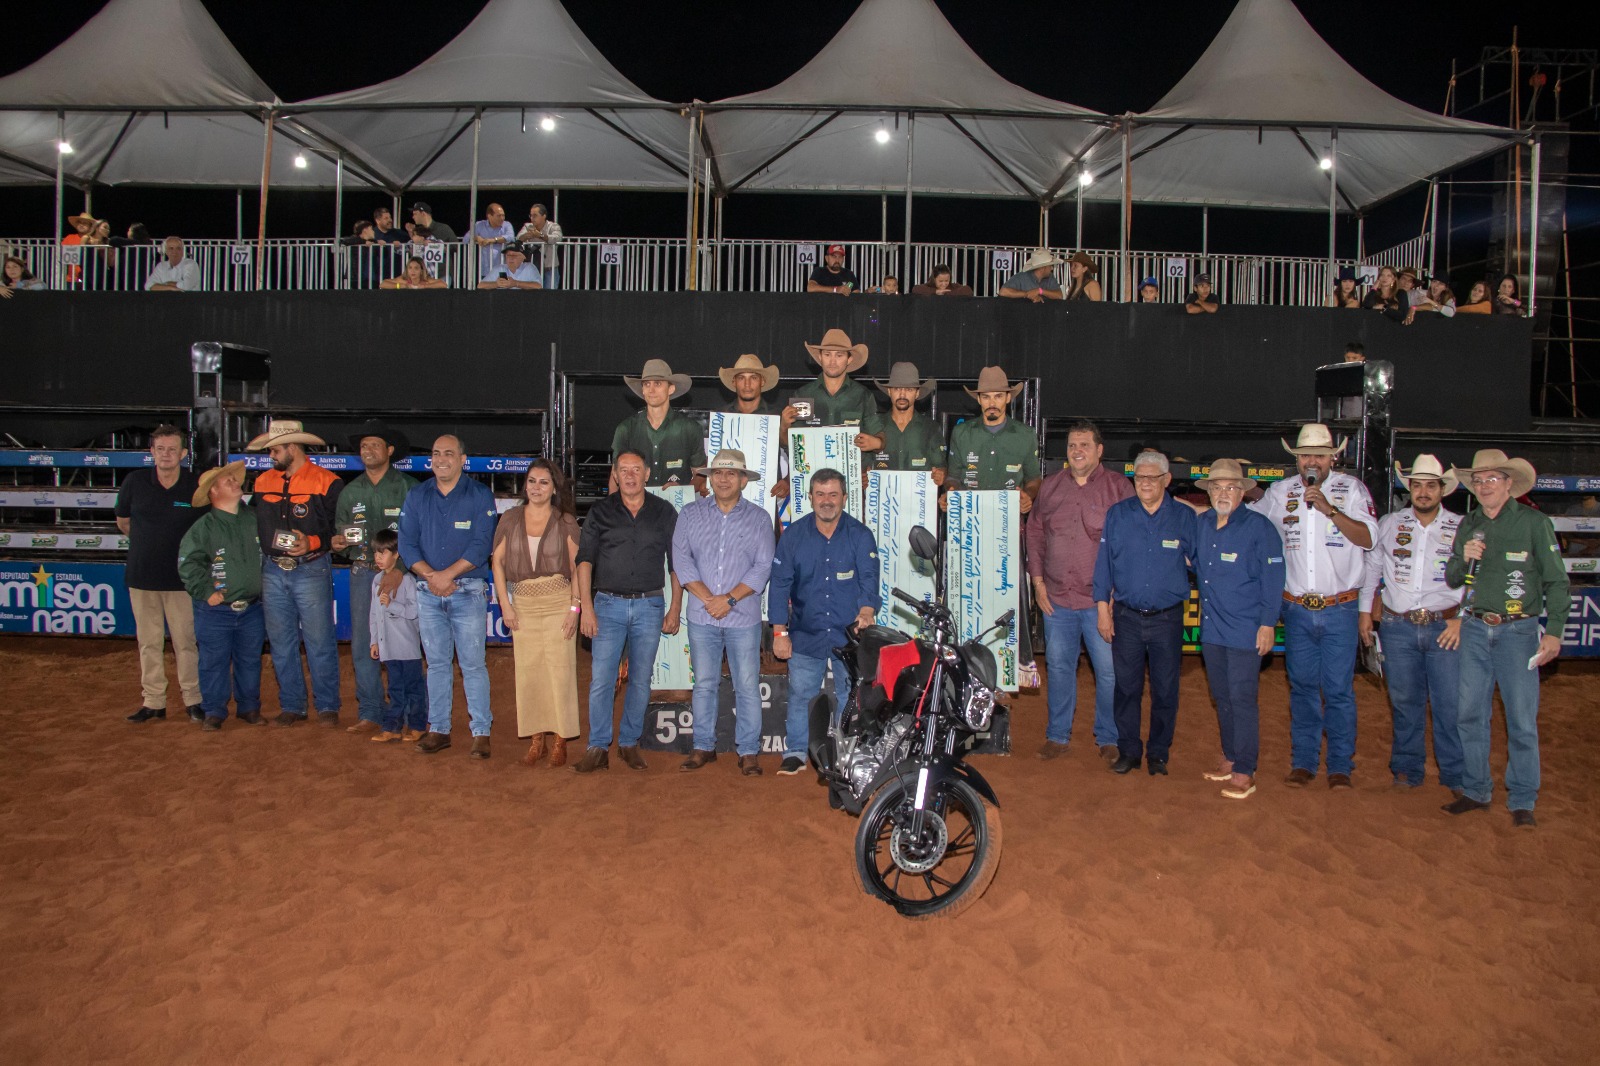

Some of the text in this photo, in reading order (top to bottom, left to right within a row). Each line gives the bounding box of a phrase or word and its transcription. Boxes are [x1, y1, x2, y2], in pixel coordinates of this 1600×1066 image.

[63, 253, 78, 263] 08
[234, 252, 248, 263] 07
[426, 250, 441, 261] 06
[604, 253, 617, 263] 05
[799, 252, 813, 263] 04
[995, 259, 1009, 269] 03
[1170, 266, 1183, 276] 02
[1364, 274, 1375, 284] 01
[825, 434, 836, 459] start
[487, 459, 502, 470] JG
[792, 474, 805, 514] Iguatemi
[881, 488, 891, 537] reais
[880, 543, 890, 574] mil
[1, 572, 83, 581] DEPUTADO ESTADUAL
[965, 580, 973, 589] e
[963, 593, 973, 618] mil
[33, 610, 116, 634] name
